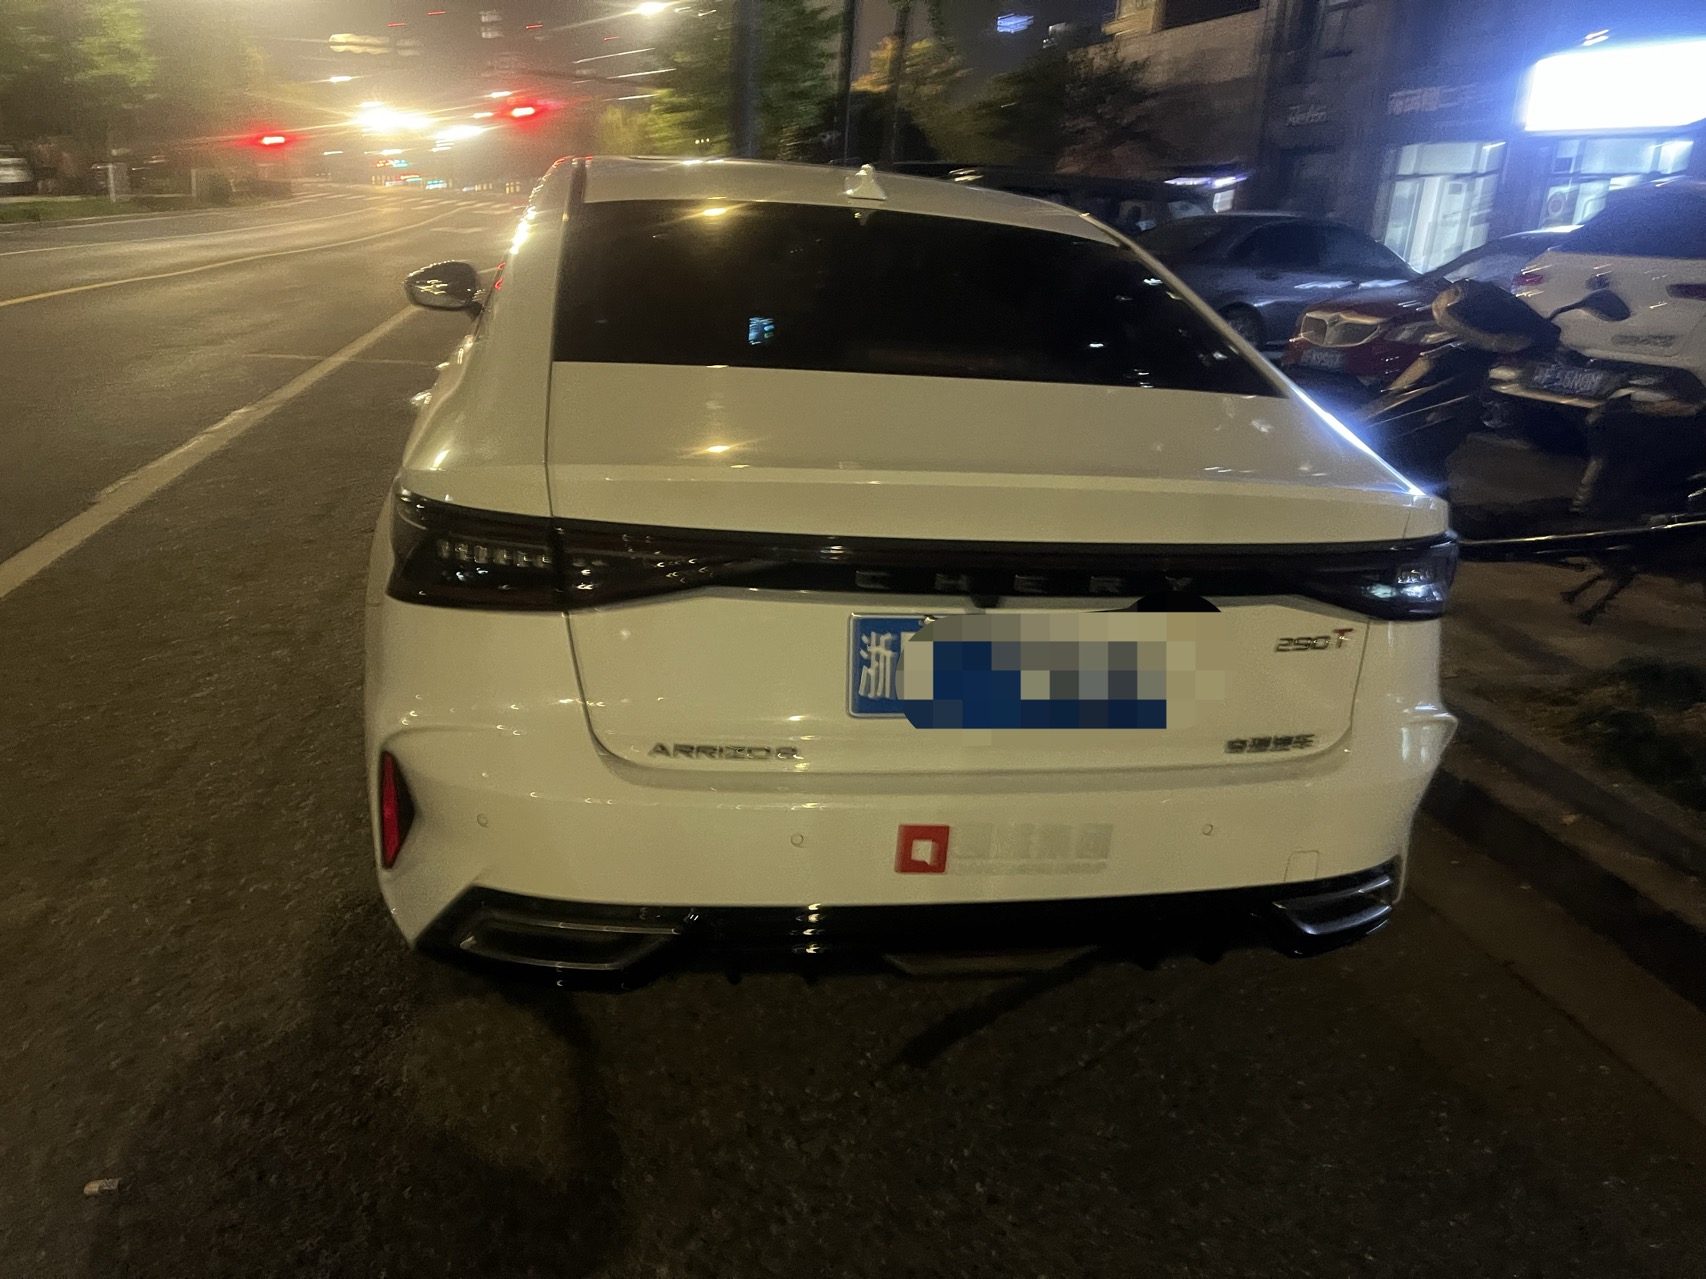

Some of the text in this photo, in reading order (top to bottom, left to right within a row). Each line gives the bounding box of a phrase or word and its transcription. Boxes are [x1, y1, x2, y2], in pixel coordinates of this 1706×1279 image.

[855, 569, 1193, 594] CHERY
[858, 631, 898, 700] 浙
[648, 742, 772, 760] ARRIZO
